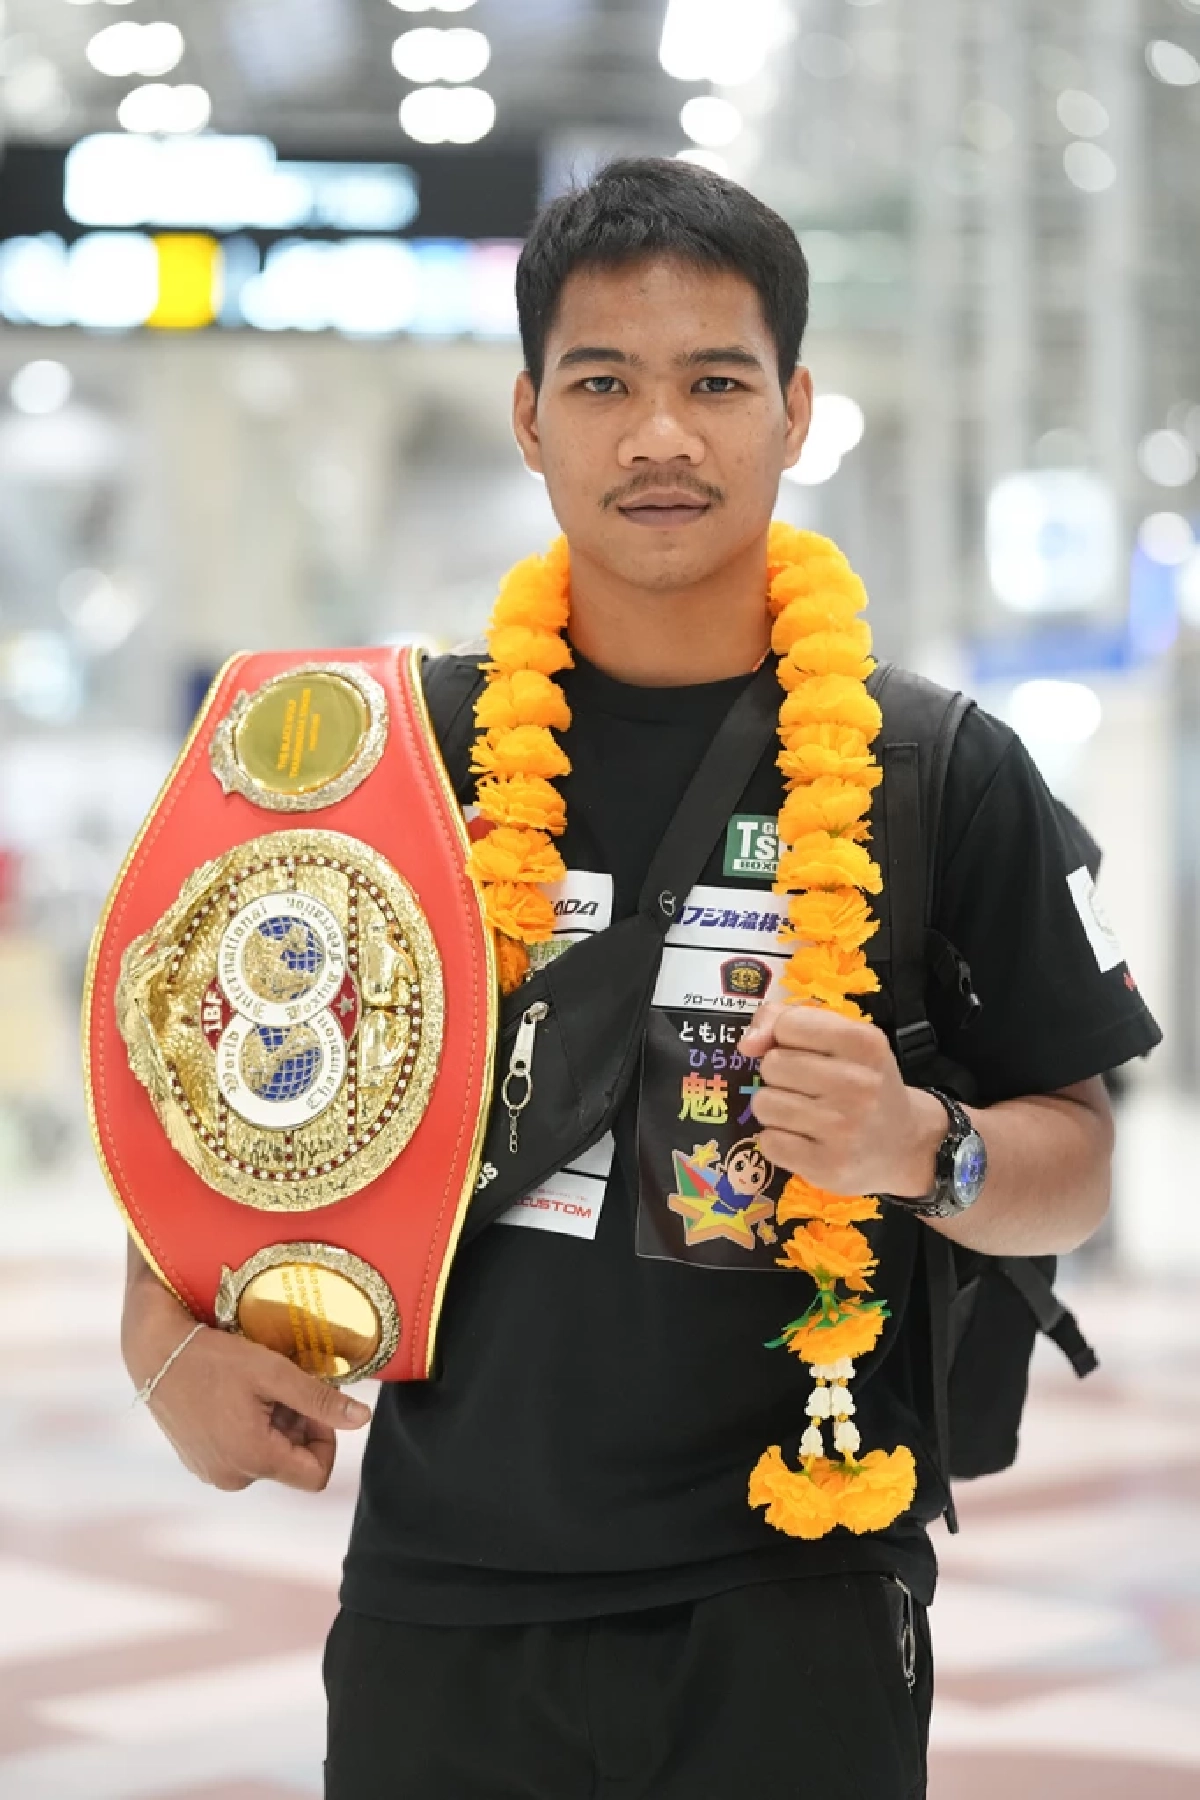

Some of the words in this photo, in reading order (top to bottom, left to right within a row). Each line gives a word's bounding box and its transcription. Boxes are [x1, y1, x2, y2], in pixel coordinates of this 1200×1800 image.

[762, 822, 779, 834] G
[551, 898, 599, 916] ADA
[675, 905, 795, 933] フジ物流株
[223, 899, 266, 1018] International
[203, 991, 222, 1033] IBF
[683, 992, 764, 1009] グローバルサー
[679, 1020, 751, 1044] ともに
[223, 1029, 240, 1095] World
[305, 1014, 341, 1110] Champion
[515, 1195, 592, 1219] CUSTOM
